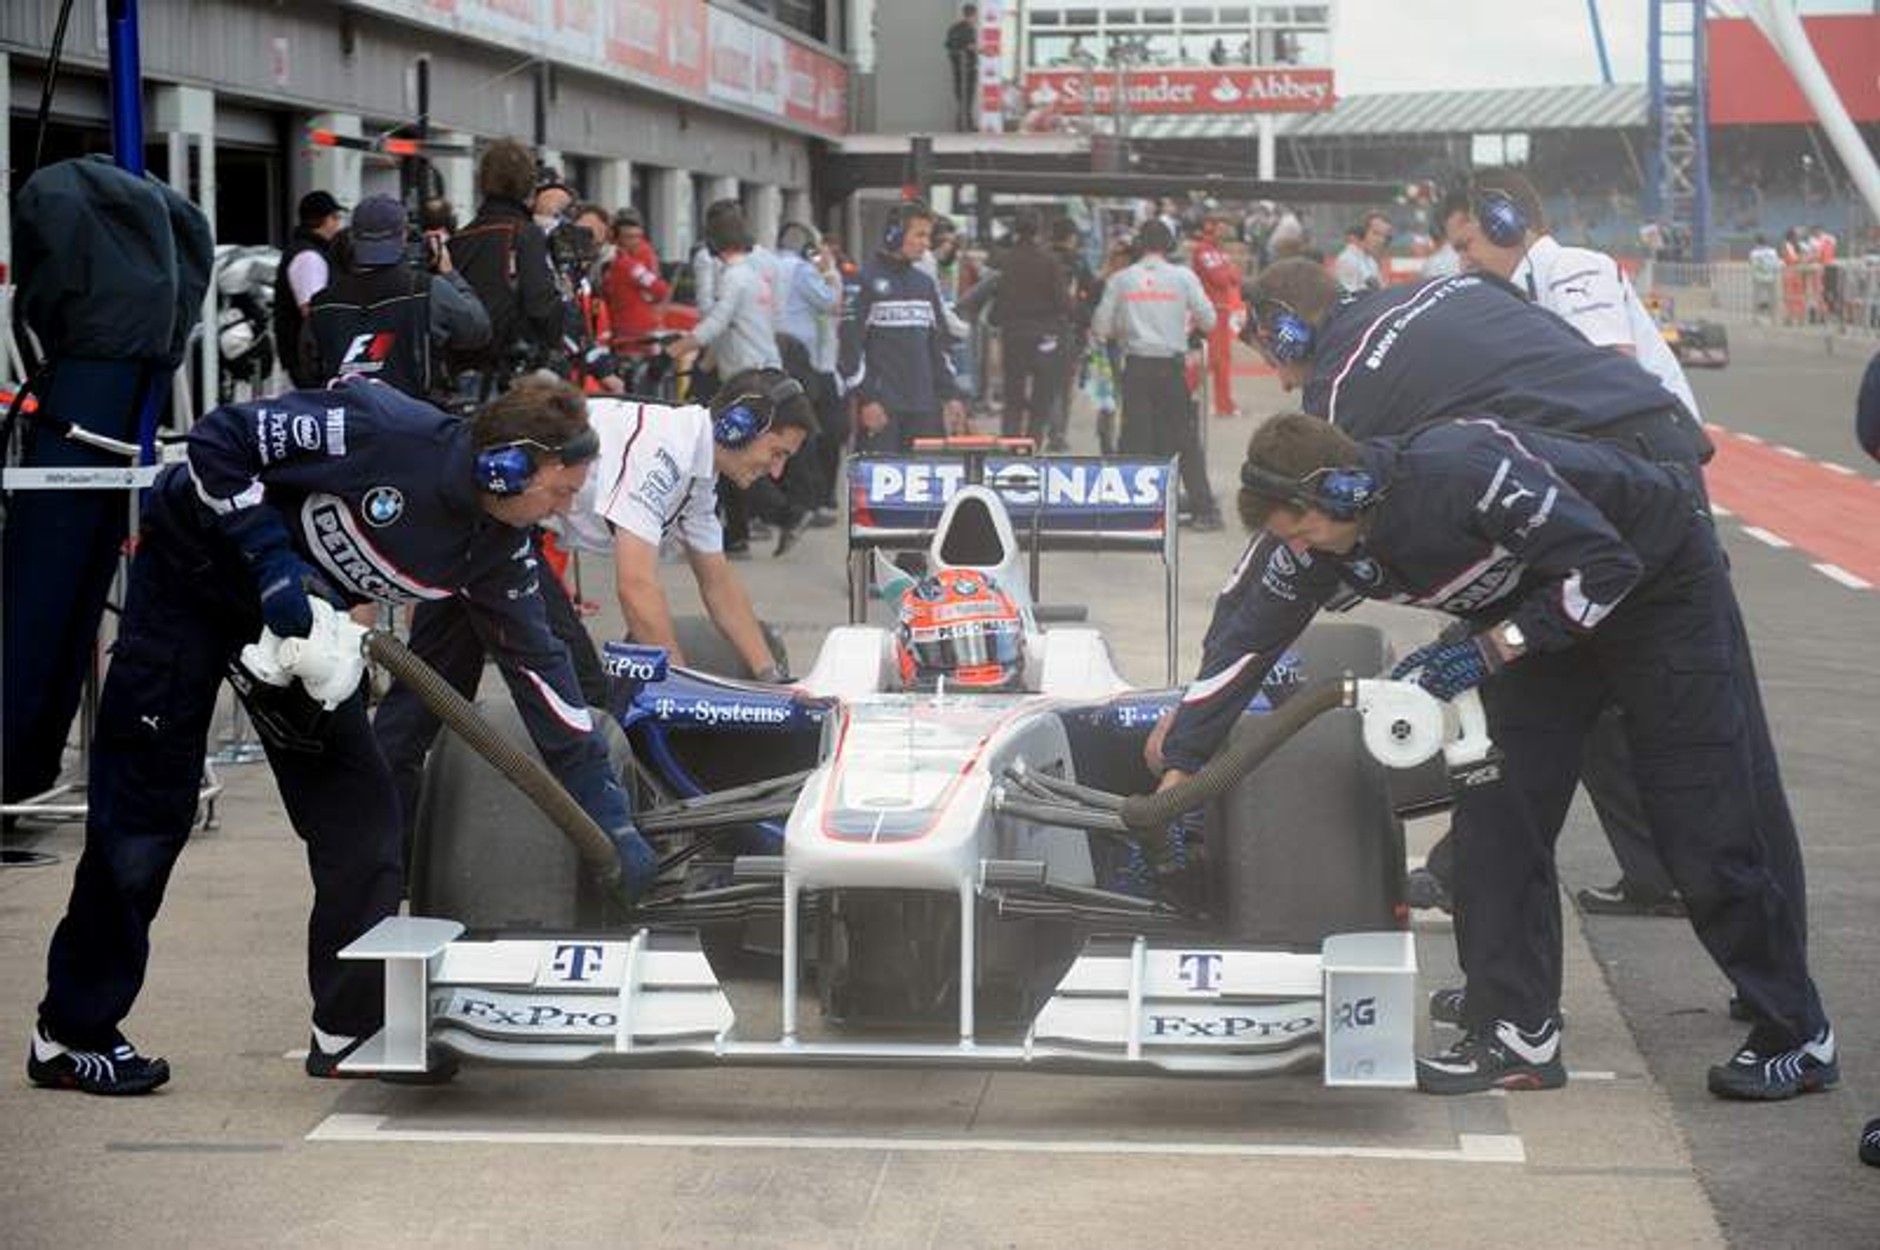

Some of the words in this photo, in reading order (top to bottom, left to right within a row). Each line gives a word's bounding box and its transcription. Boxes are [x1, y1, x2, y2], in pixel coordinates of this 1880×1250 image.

[1062, 77, 1196, 103] Snander
[1246, 76, 1328, 105] Abbey
[870, 464, 1161, 505] PETONAS
[462, 998, 617, 1027] FxPro
[1150, 1015, 1316, 1037] FxPro
